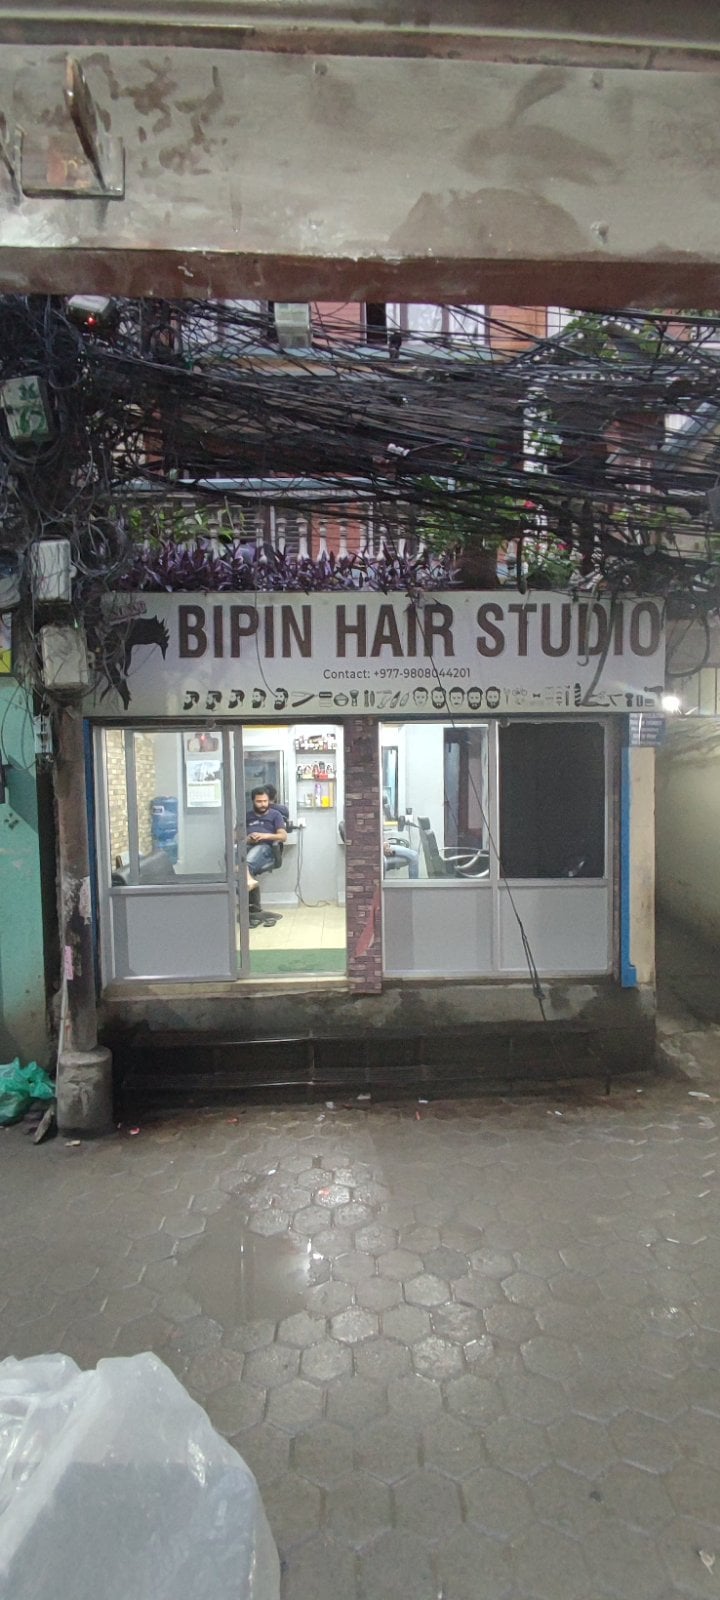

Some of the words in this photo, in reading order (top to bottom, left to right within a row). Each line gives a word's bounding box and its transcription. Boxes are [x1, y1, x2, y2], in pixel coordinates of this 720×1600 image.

[178, 604, 312, 658] BIPIN
[336, 603, 455, 657] HAIR
[476, 601, 661, 657] STUDIO
[323, 669, 371, 679] Contact:
[373, 667, 471, 679] +977-9808044201
